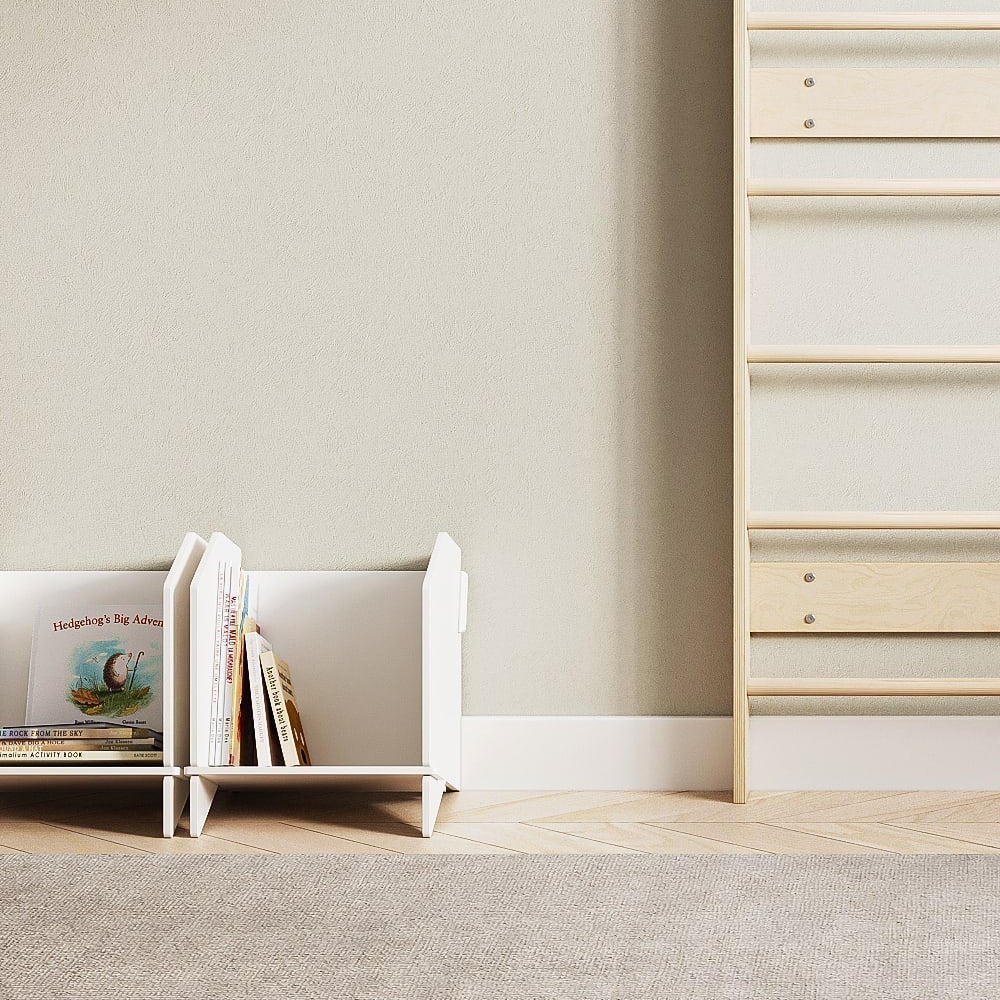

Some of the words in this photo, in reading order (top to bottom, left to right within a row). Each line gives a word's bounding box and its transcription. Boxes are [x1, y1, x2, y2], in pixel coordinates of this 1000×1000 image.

[53, 614, 111, 631] Hedgehog's
[114, 613, 130, 625] Big
[266, 666, 277, 691] Another
[272, 690, 282, 707] book
[276, 707, 286, 726] about
[280, 724, 289, 742] bears
